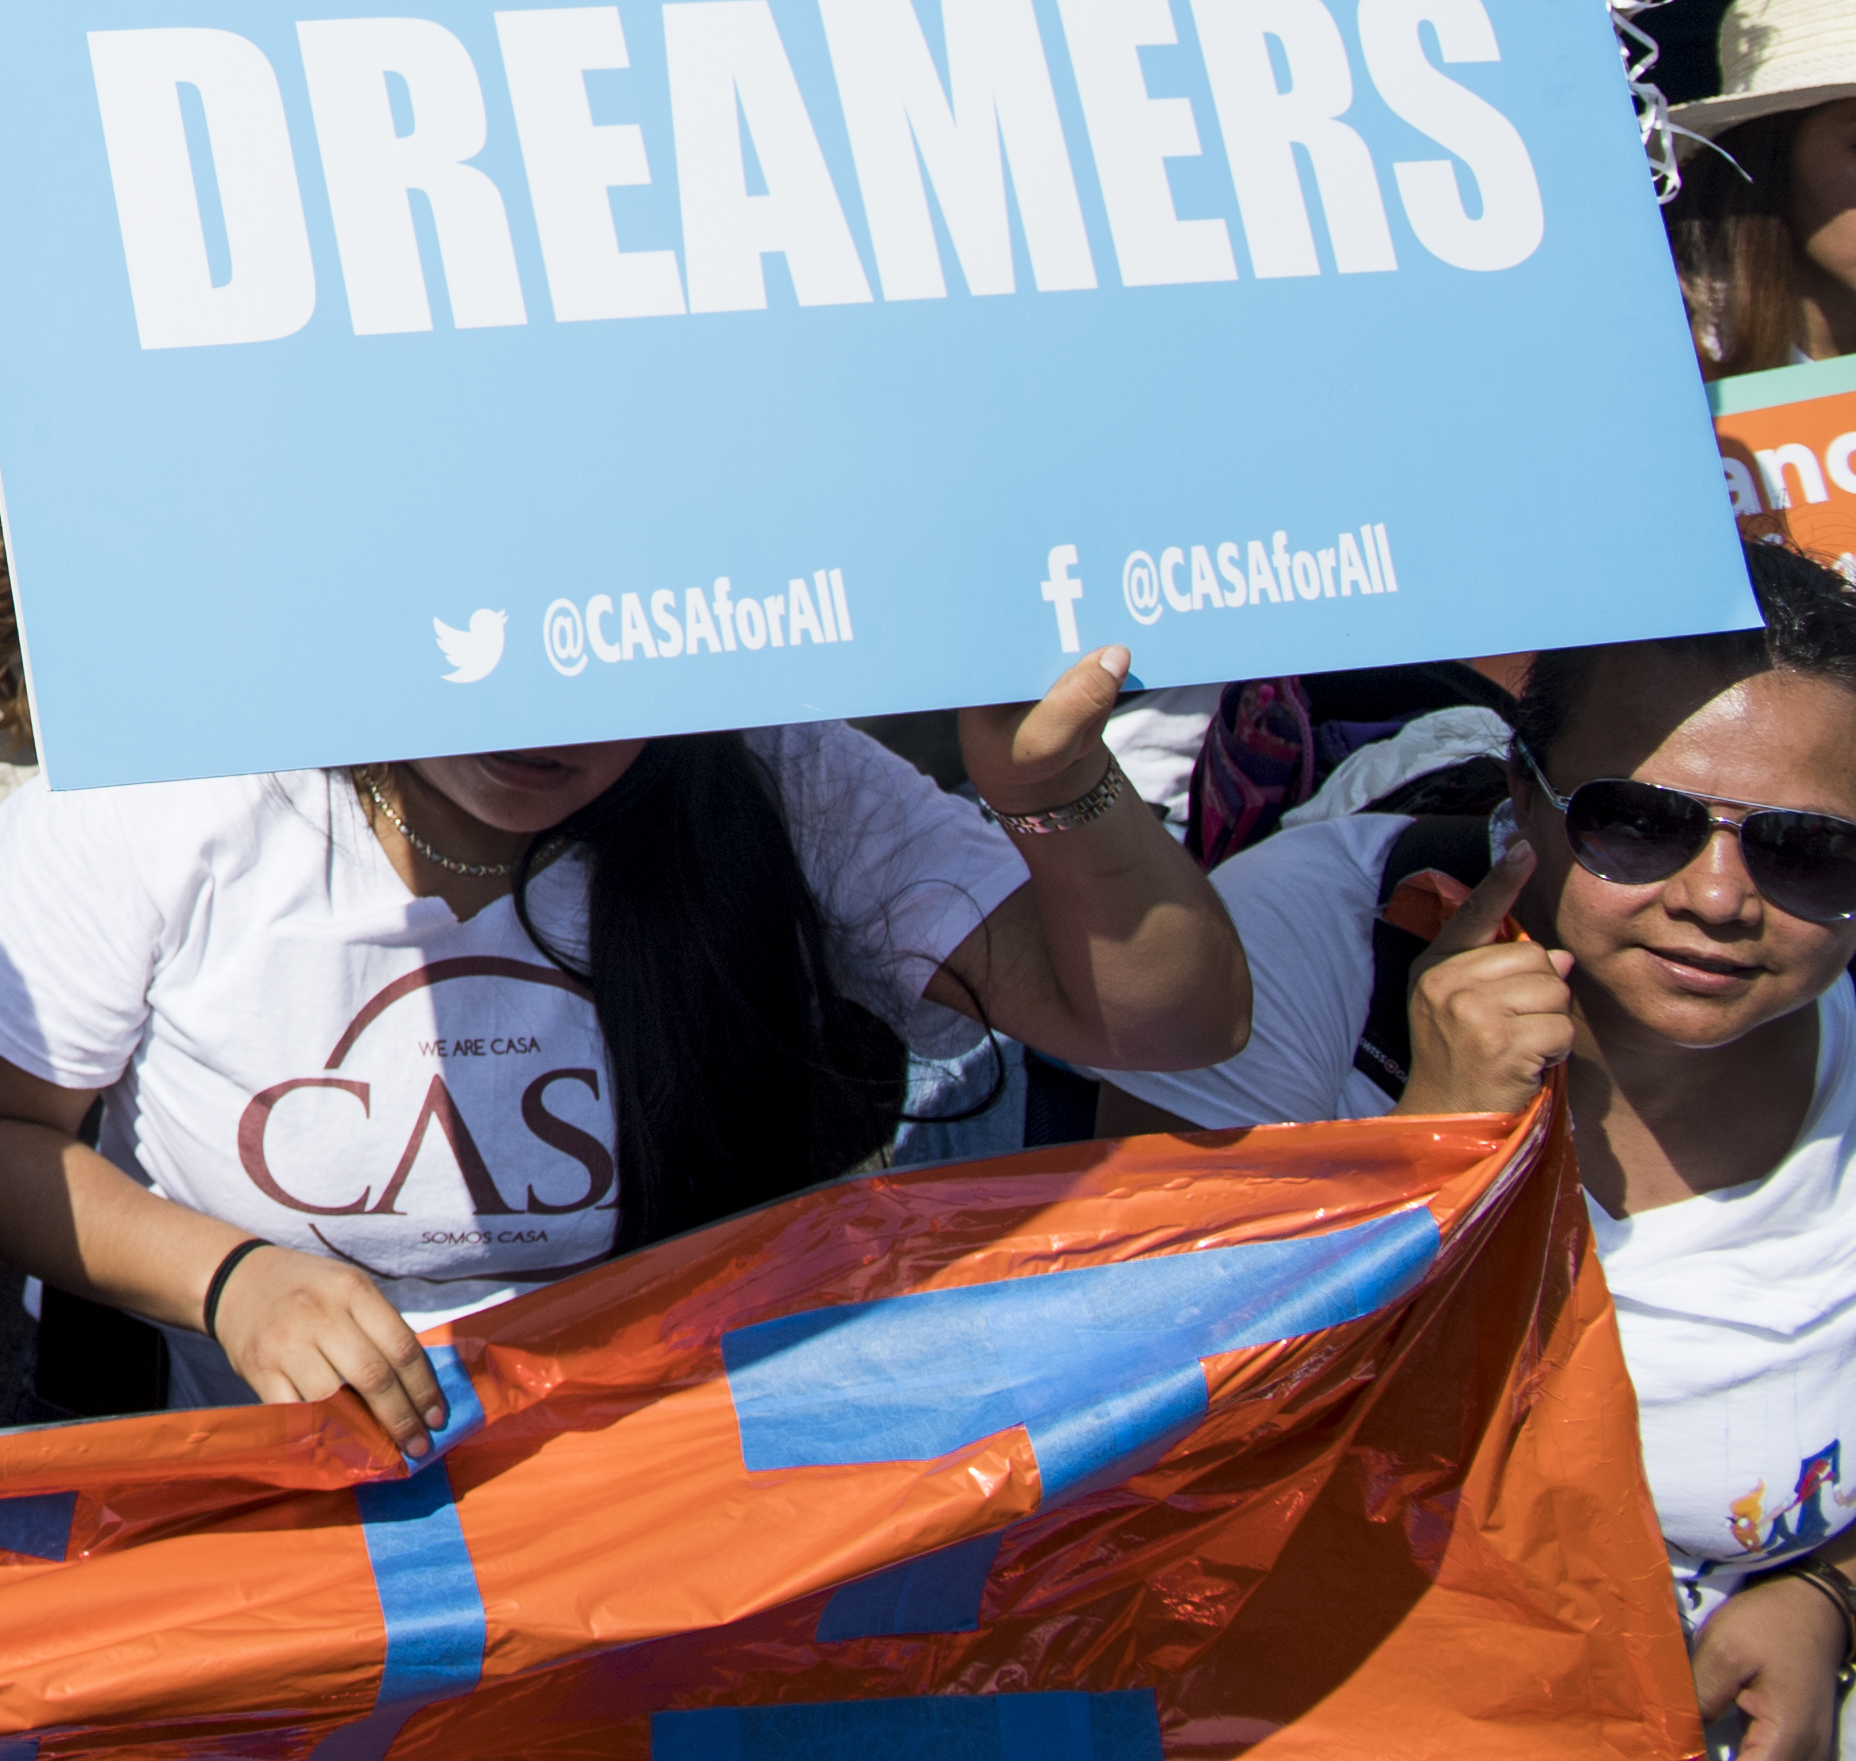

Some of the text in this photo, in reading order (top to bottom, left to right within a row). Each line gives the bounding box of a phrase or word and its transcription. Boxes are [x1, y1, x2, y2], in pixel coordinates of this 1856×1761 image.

[543, 568, 854, 677] @CASAforAll
[1122, 522, 1397, 626] @CASAforAll
[418, 1037, 542, 1057] WE ARE CASA
[238, 1068, 621, 1216] CAS
[421, 1229, 549, 1245] SOMOS CASA
